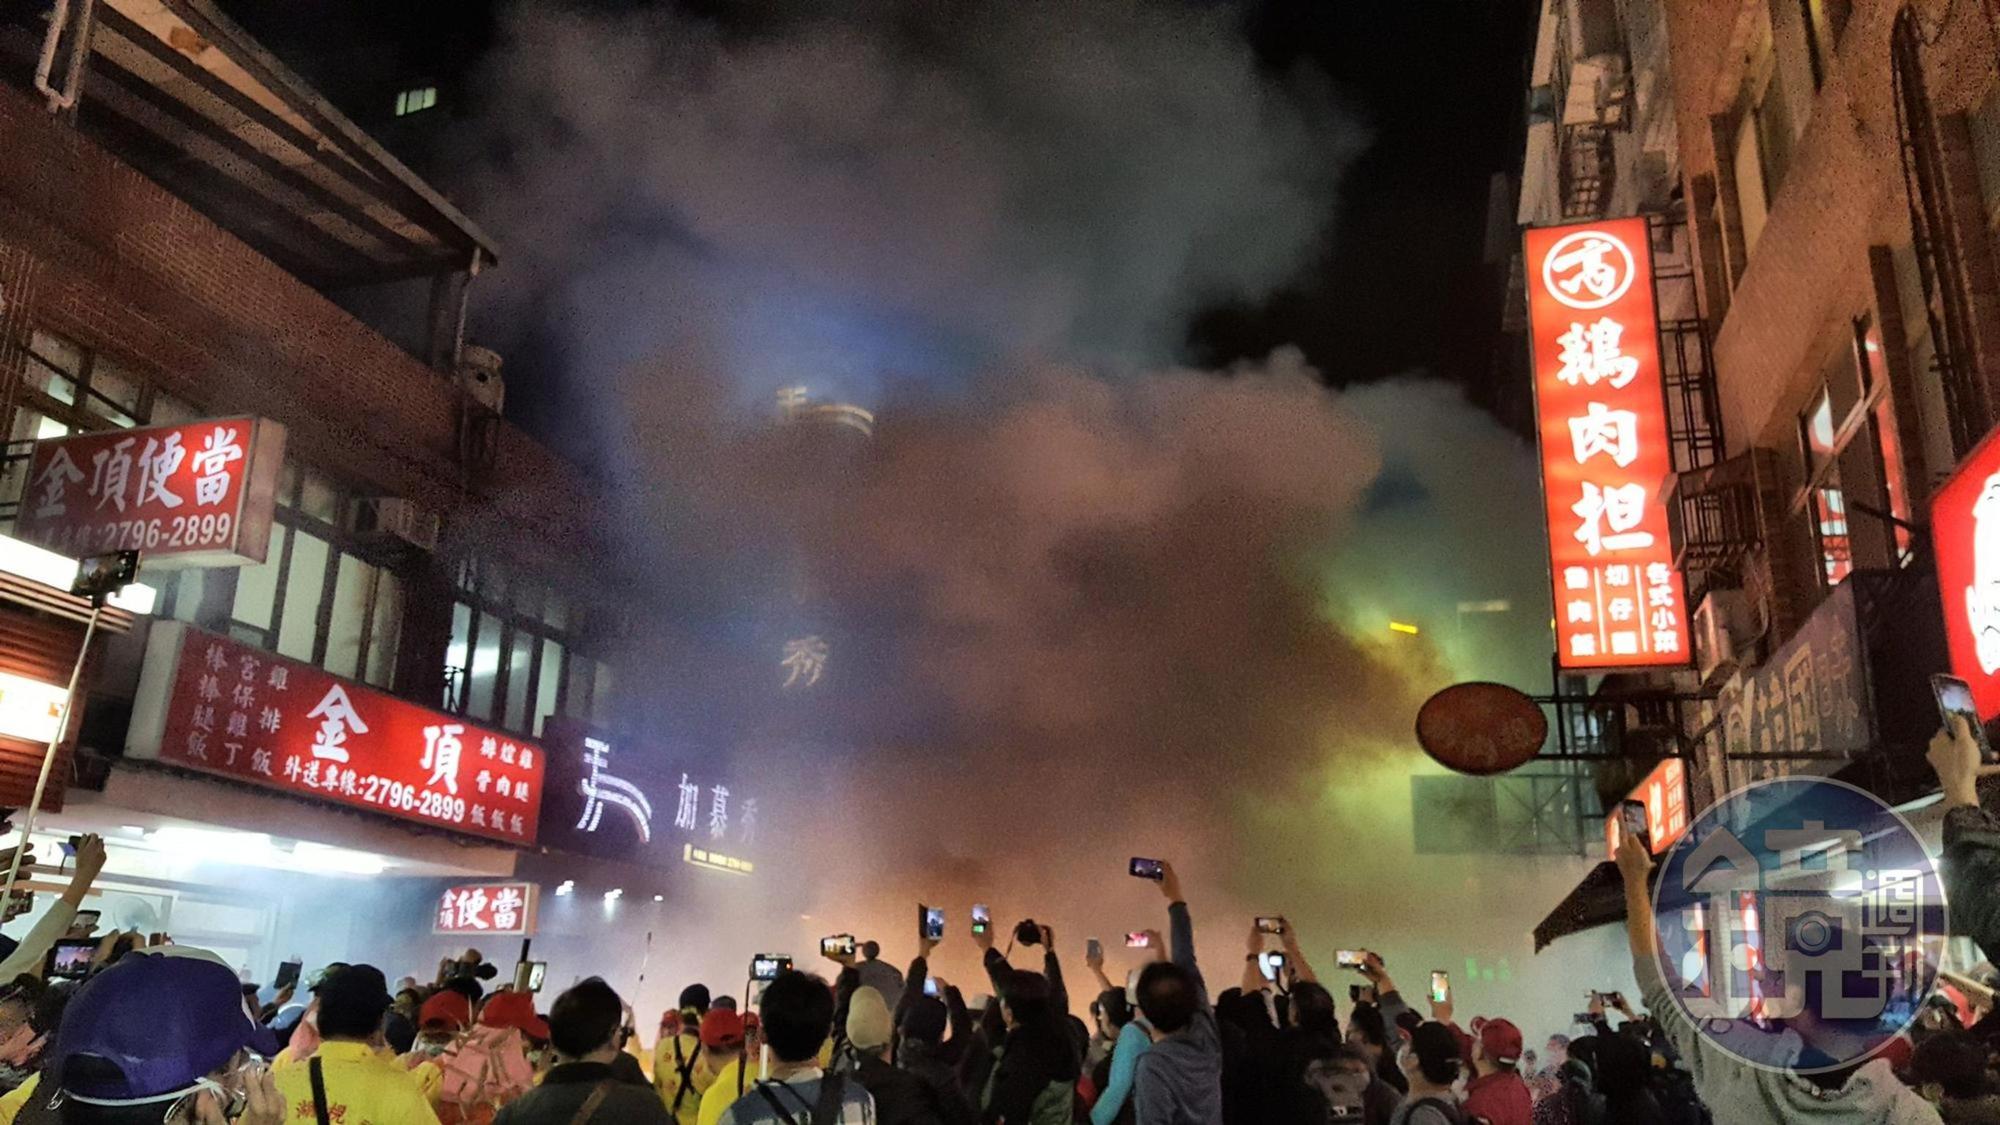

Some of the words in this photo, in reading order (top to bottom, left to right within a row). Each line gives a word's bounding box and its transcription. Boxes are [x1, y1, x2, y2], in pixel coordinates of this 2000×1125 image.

[34, 427, 243, 519] 金頂便當
[1556, 316, 1654, 557] 鵝肉担
[1646, 561, 1680, 654] 各式小菜
[306, 683, 466, 795] 金頂
